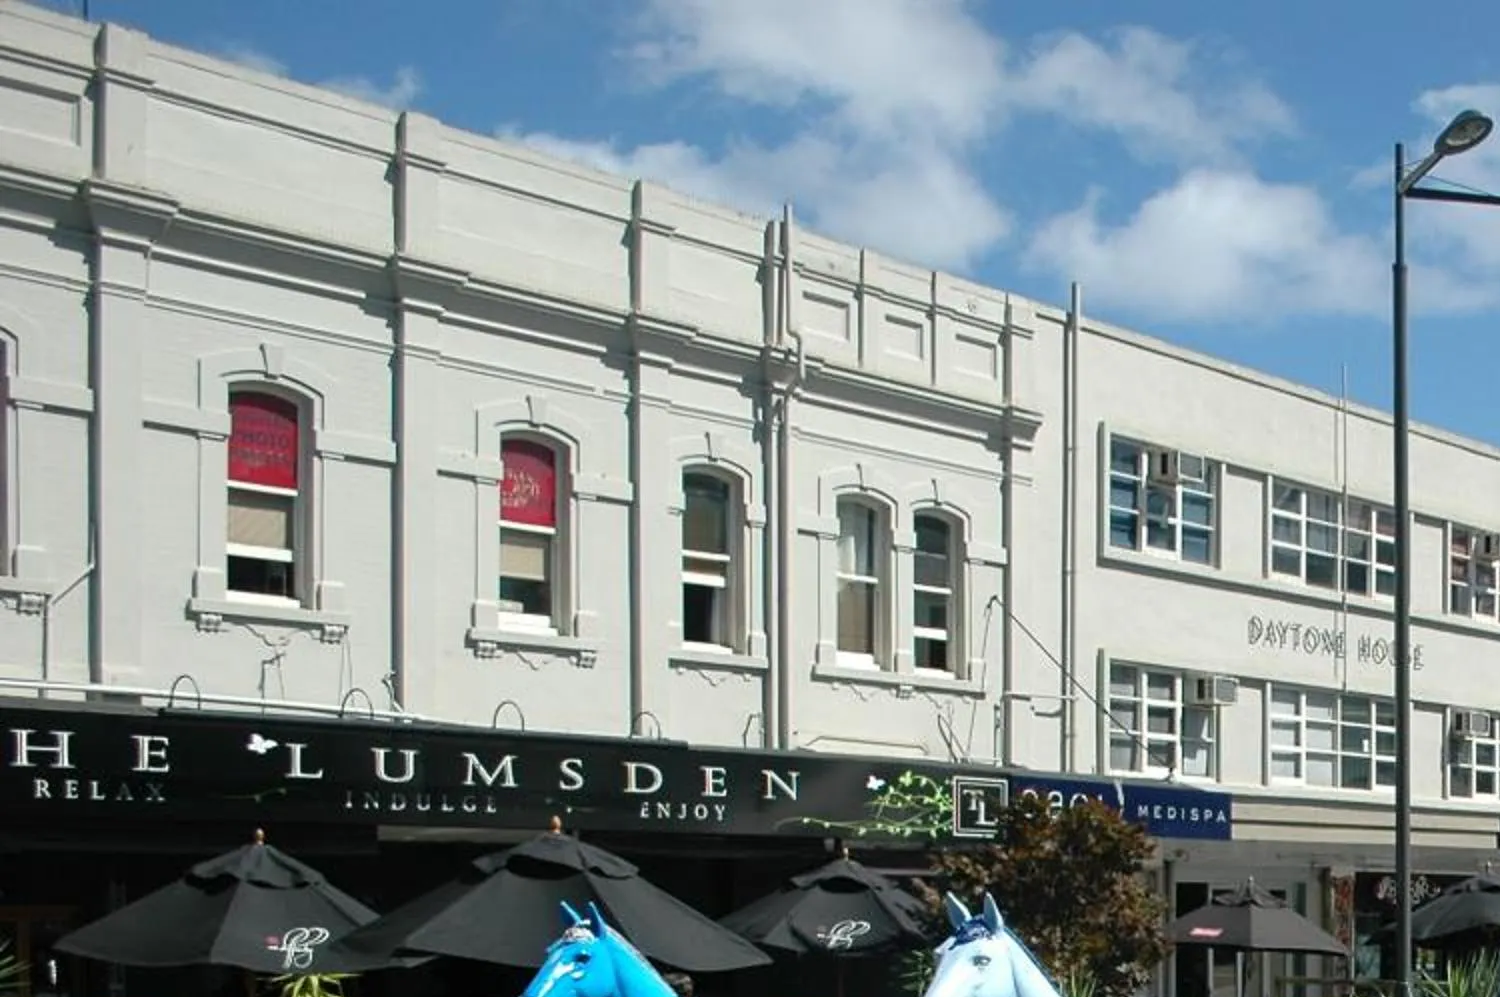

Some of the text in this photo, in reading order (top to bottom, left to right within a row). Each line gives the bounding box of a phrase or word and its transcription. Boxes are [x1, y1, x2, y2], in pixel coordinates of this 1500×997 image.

[1357, 633, 1425, 671] HOE
[284, 742, 800, 801] LUMSDEN
[33, 778, 166, 801] RELAX
[344, 790, 497, 814] INDULGE
[640, 801, 727, 822] ENJOY
[1137, 804, 1227, 823] MEDISPA
